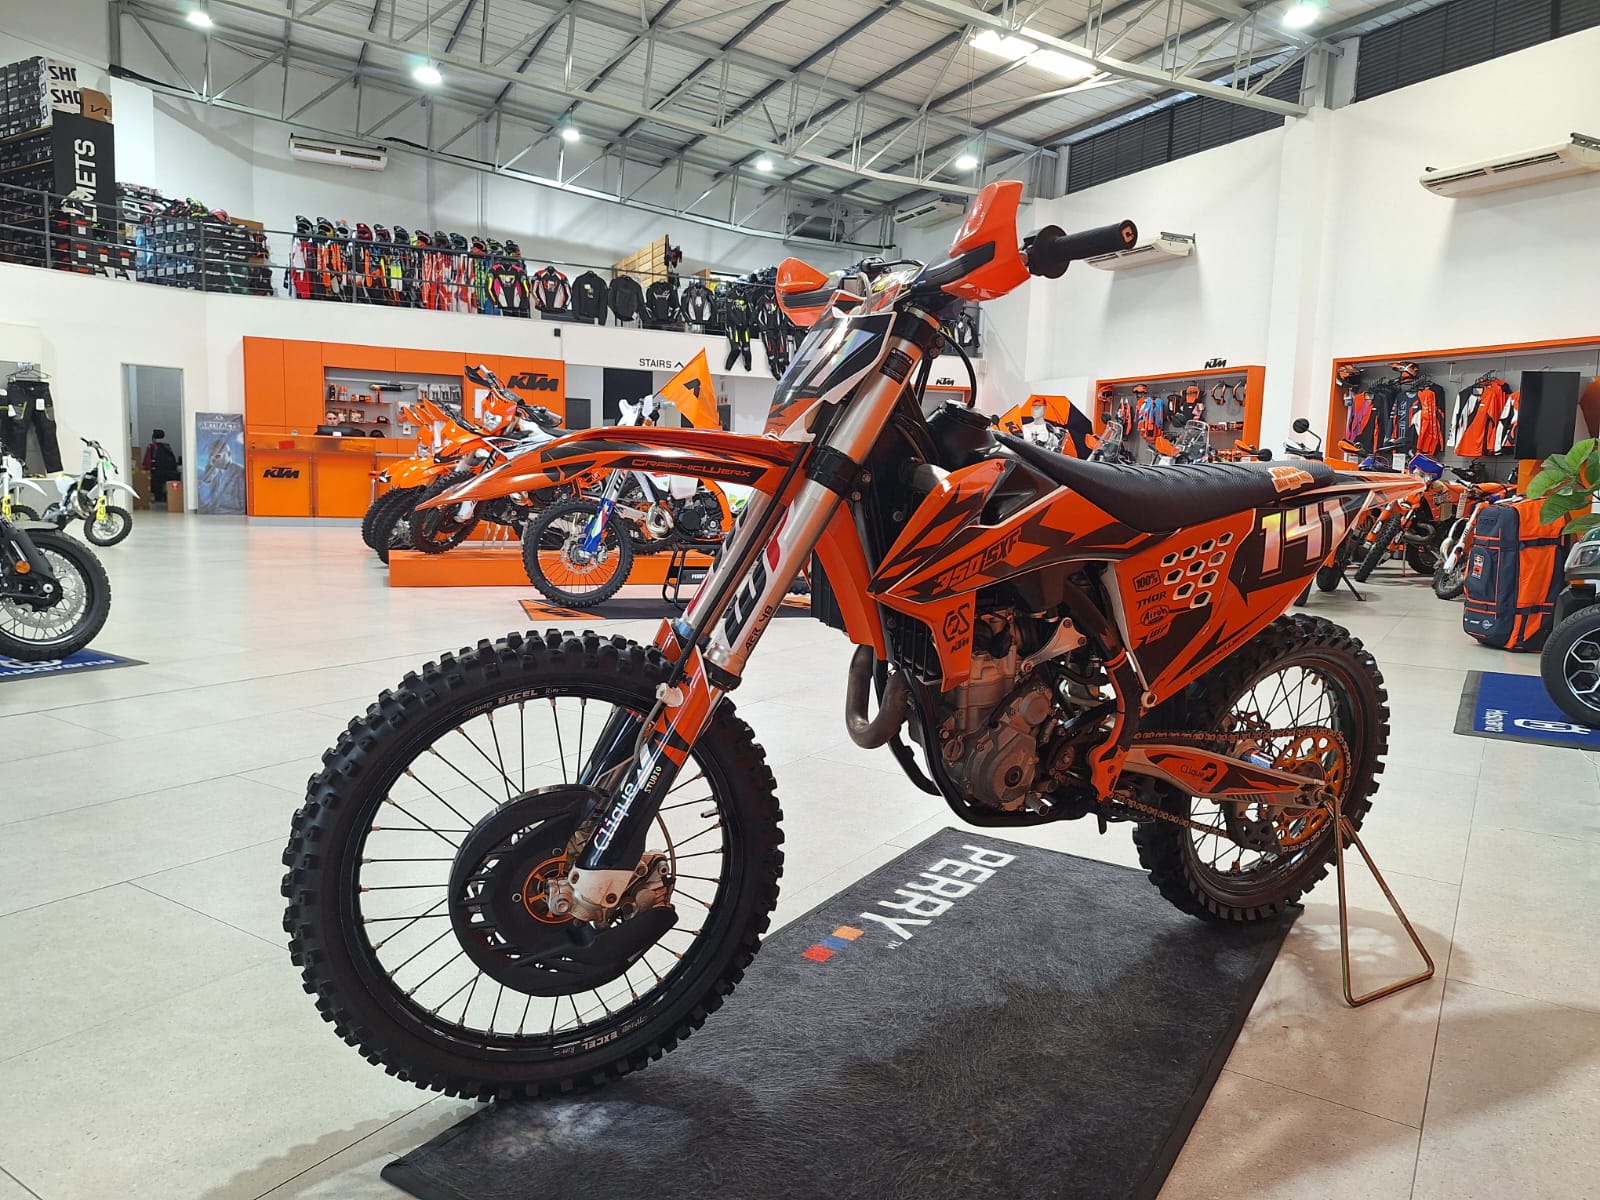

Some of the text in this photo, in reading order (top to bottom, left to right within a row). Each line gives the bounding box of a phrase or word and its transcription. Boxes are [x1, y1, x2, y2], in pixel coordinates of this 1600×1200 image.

[639, 358, 672, 369] STAIRS
[1204, 357, 1227, 370] KTM
[507, 372, 560, 392] KTM
[935, 377, 955, 386] KTM
[263, 466, 300, 479] KTM
[1261, 498, 1346, 574] 141
[1134, 571, 1159, 590] 100%
[1136, 590, 1167, 608] THOR
[745, 627, 762, 651] AER
[497, 689, 538, 704] EXCEL
[644, 766, 662, 794] STUDIO
[859, 844, 1017, 941] PERRY
[581, 1030, 618, 1050] EXCEL
